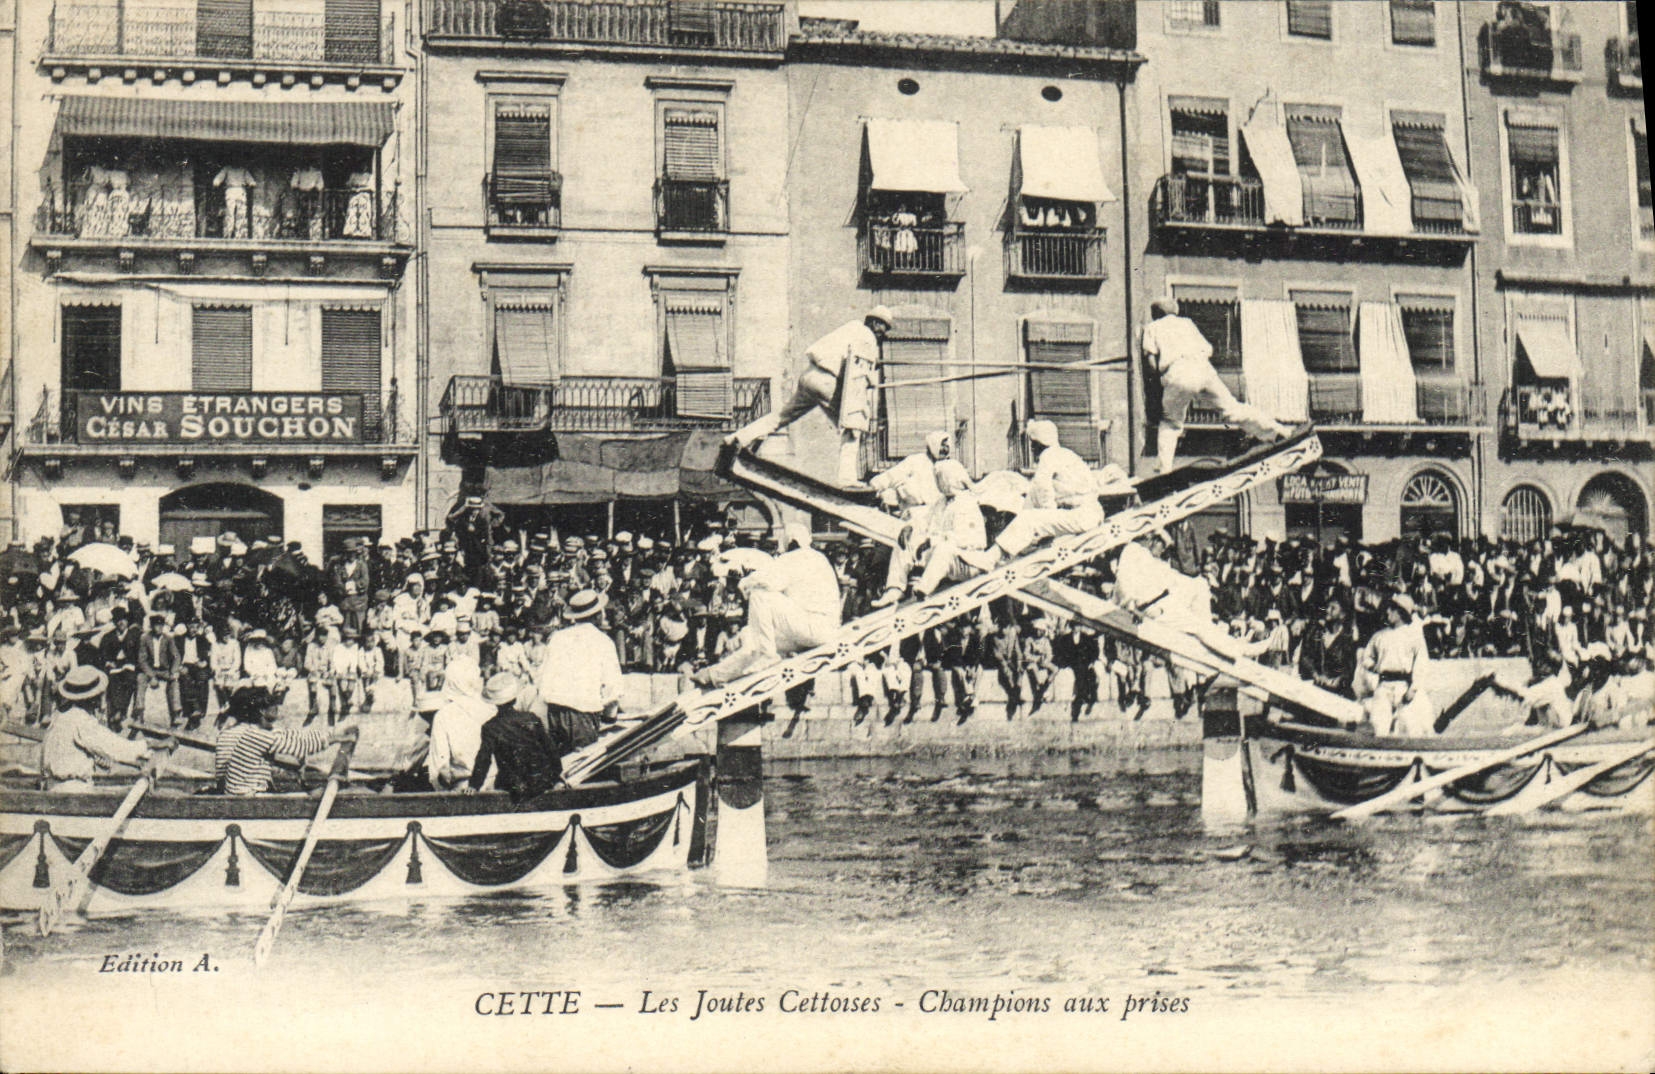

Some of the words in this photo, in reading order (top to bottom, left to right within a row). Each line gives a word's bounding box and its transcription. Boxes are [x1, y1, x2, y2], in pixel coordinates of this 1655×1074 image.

[100, 396, 163, 414] VINS
[182, 394, 343, 414] ÉTRANGERS
[86, 416, 169, 438] CÉSAR
[180, 415, 357, 438] SOUCHON
